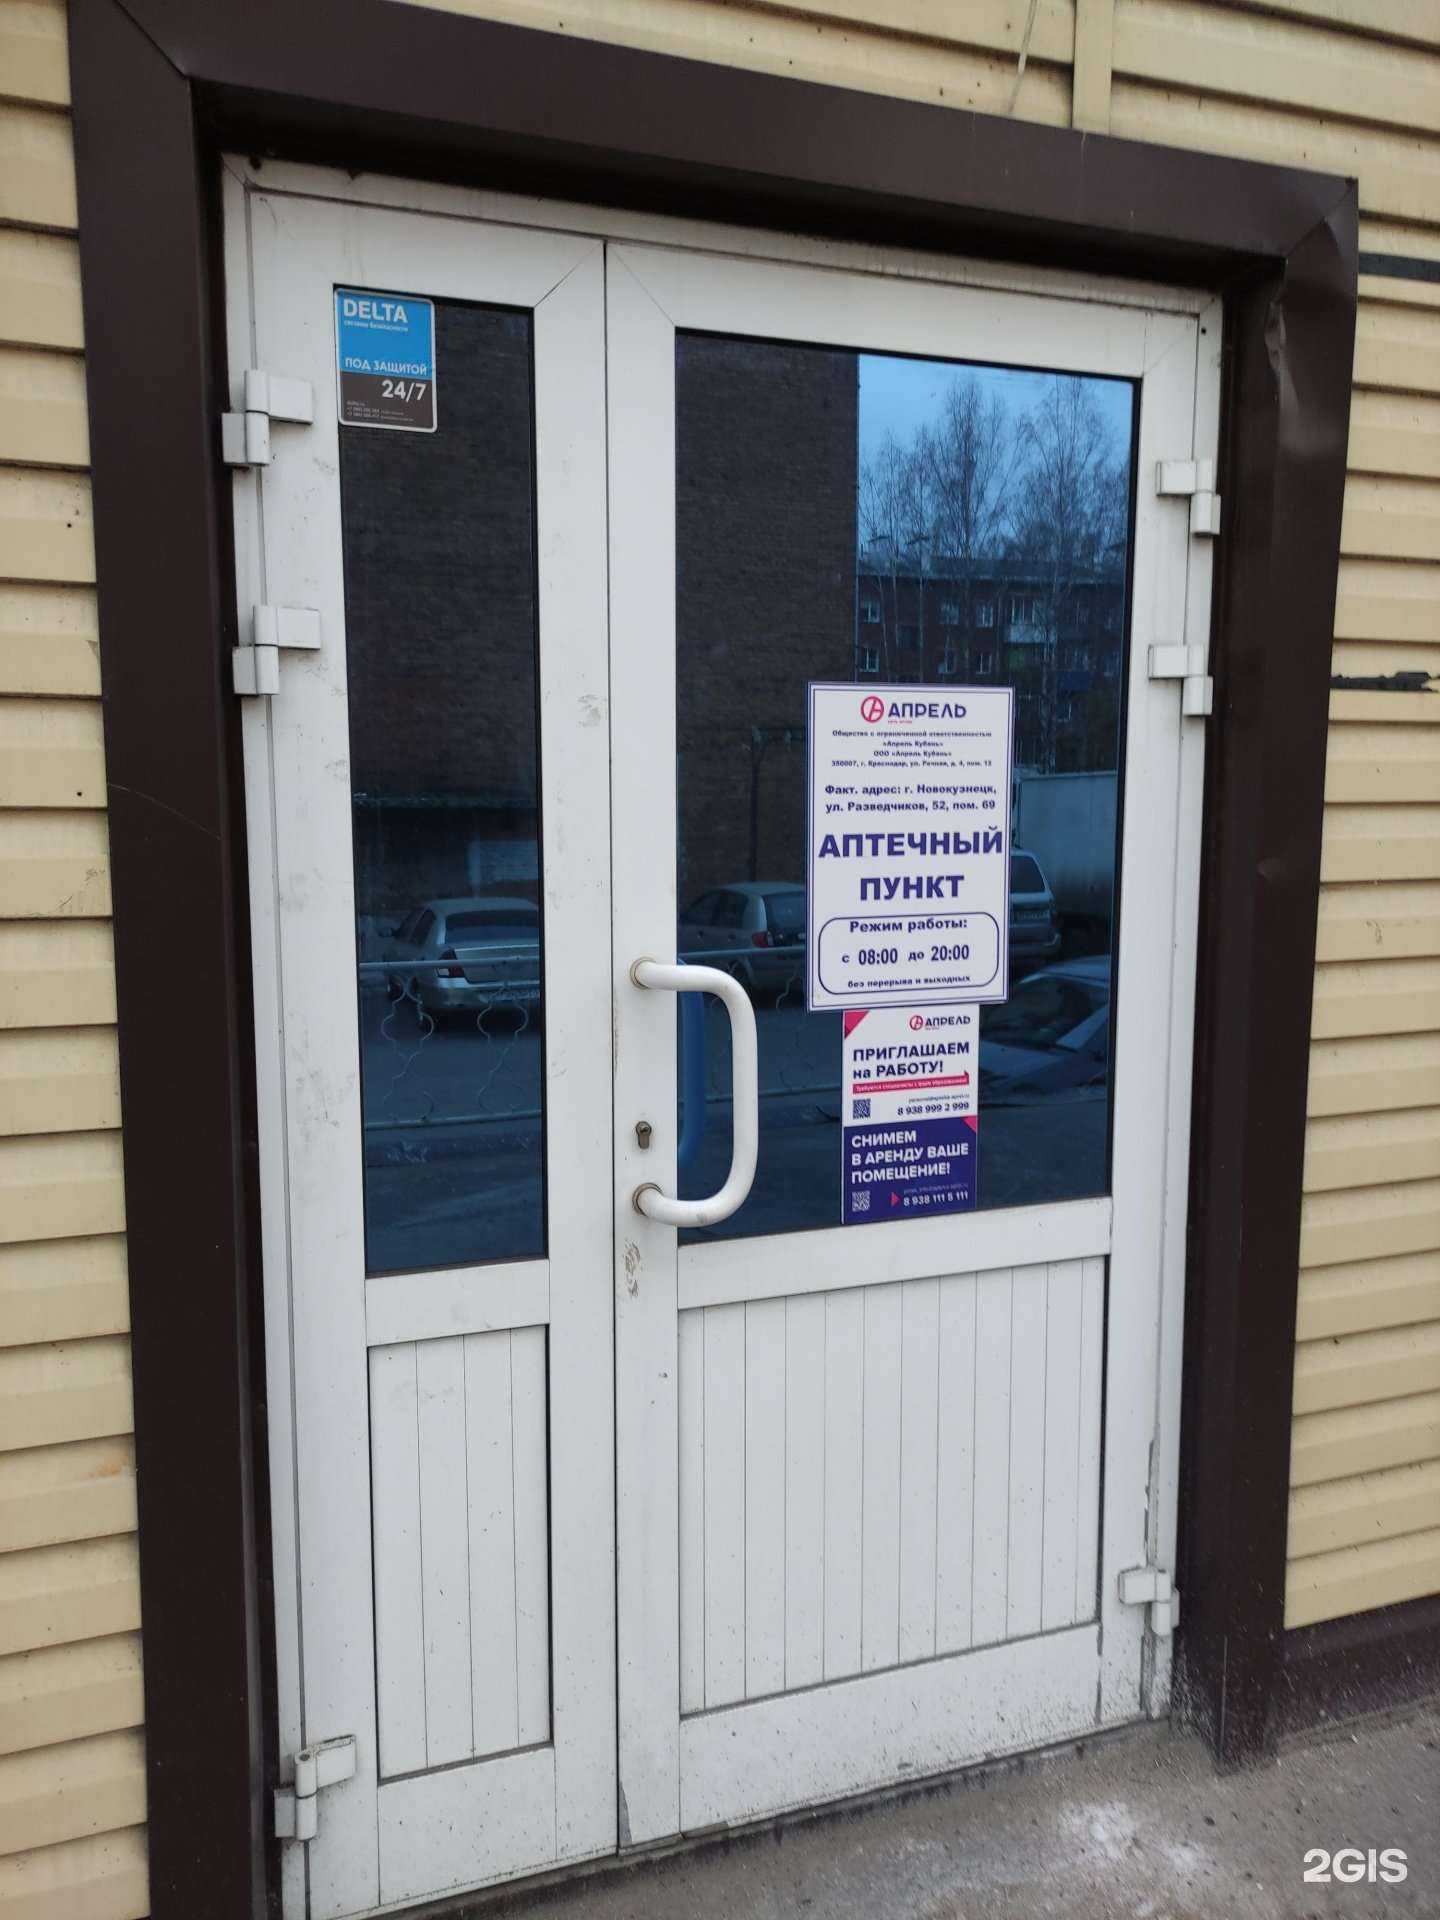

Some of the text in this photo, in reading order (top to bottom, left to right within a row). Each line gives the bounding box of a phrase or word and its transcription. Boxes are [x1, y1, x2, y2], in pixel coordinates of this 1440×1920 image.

[343, 298, 408, 323] DELTA
[345, 357, 427, 376] ПОД ЗАЩИТОЙ
[382, 380, 426, 402] 24/7
[888, 703, 967, 718] АПРЕЛЬ
[832, 729, 868, 737] Общество
[825, 784, 997, 797] Факт. адрес: г. Новокузнецк,
[825, 800, 995, 814] ул. Разведчиков, 52, пом. 69
[818, 826, 1002, 858] АПТЕЧНЫЙ
[860, 875, 965, 901] ПУНКТ
[850, 918, 968, 934] Режим работы:
[842, 945, 970, 965] с 08:00 до 20:00
[848, 981, 864, 989] без
[867, 979, 913, 989] перерыва
[924, 975, 970, 985] выходных
[925, 1015, 971, 1027] АПРЕЛЬ
[853, 1041, 970, 1061] ПРИГЛАШАЕМ
[853, 1060, 943, 1079] на РАБОТУ!
[897, 1107, 904, 1116] 8
[906, 1105, 923, 1115] 938
[851, 1130, 917, 1148] СНИМЕМ
[852, 1142, 969, 1166] В АРЕНДУ ВАШЕ
[852, 1162, 951, 1184] ПОМЕЩЕНИЕ!
